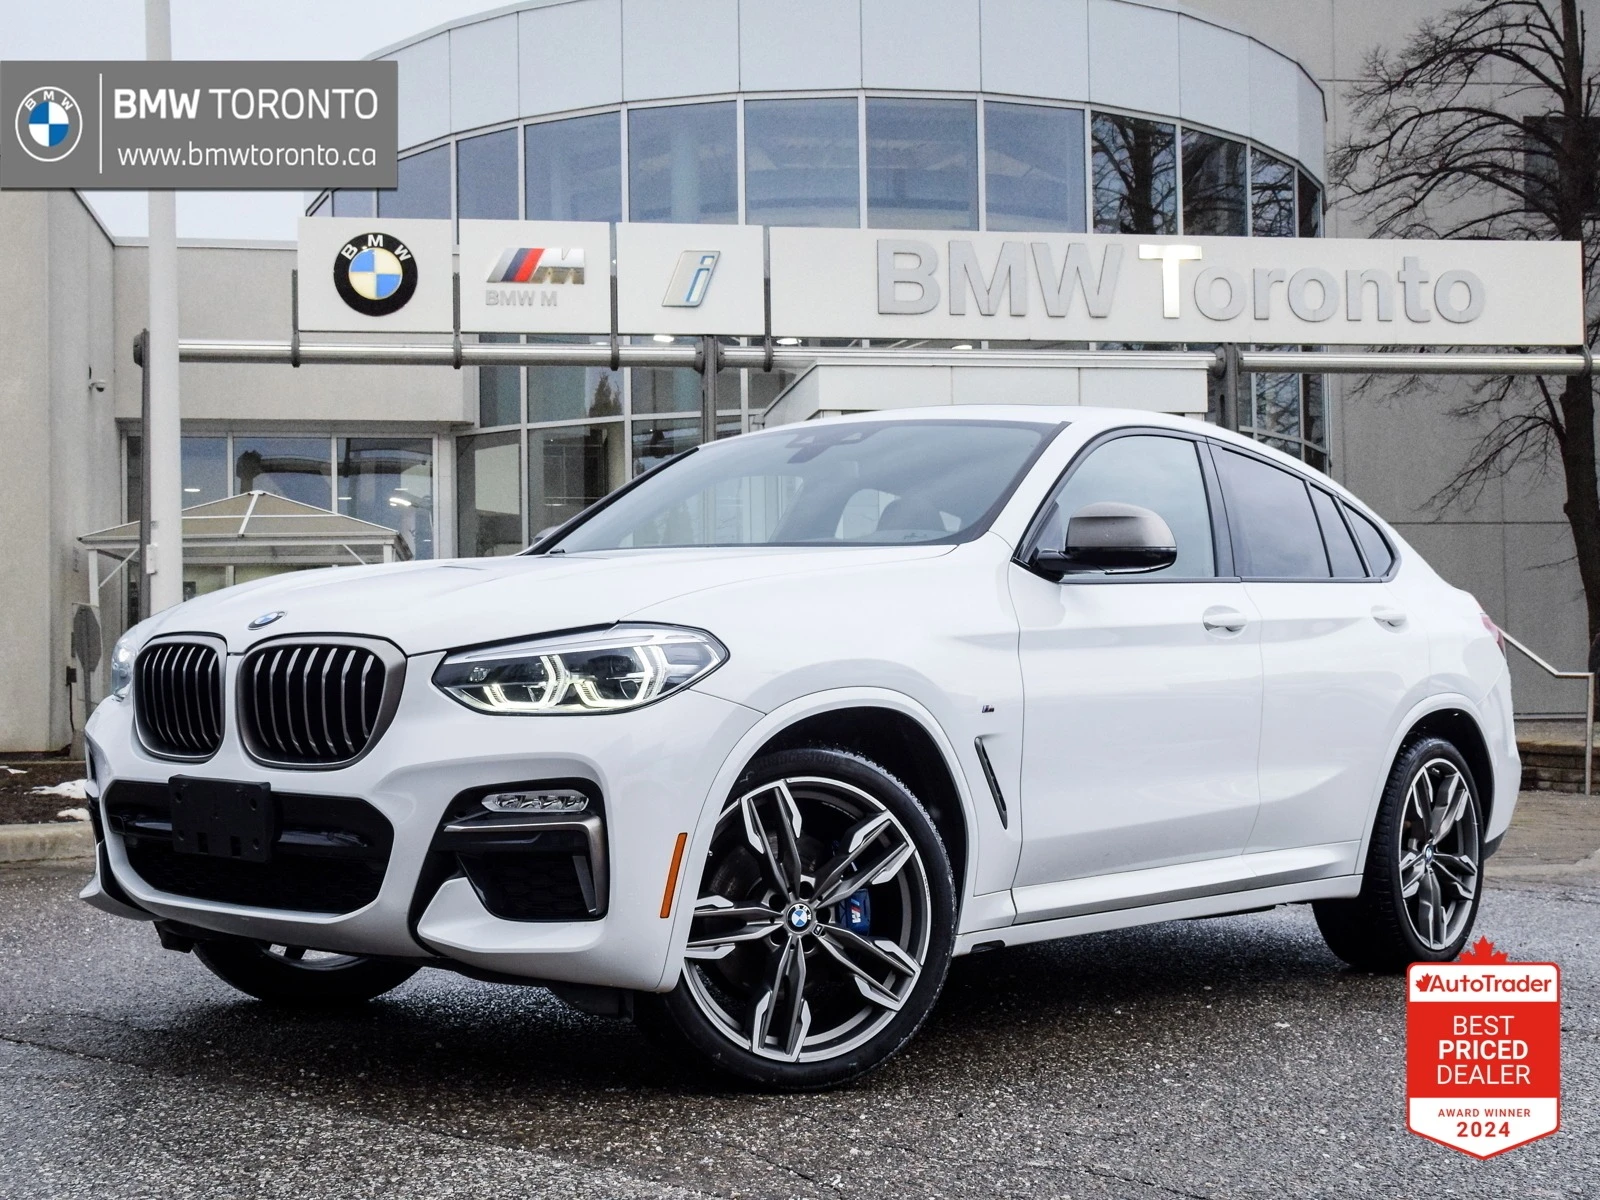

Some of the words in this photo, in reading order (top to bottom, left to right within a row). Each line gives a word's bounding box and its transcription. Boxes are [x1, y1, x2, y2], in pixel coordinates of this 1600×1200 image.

[340, 234, 412, 262] BMW
[876, 239, 1124, 318] BMW
[1138, 244, 1486, 323] Toronto
[485, 289, 535, 306] BMW
[540, 290, 558, 307] M
